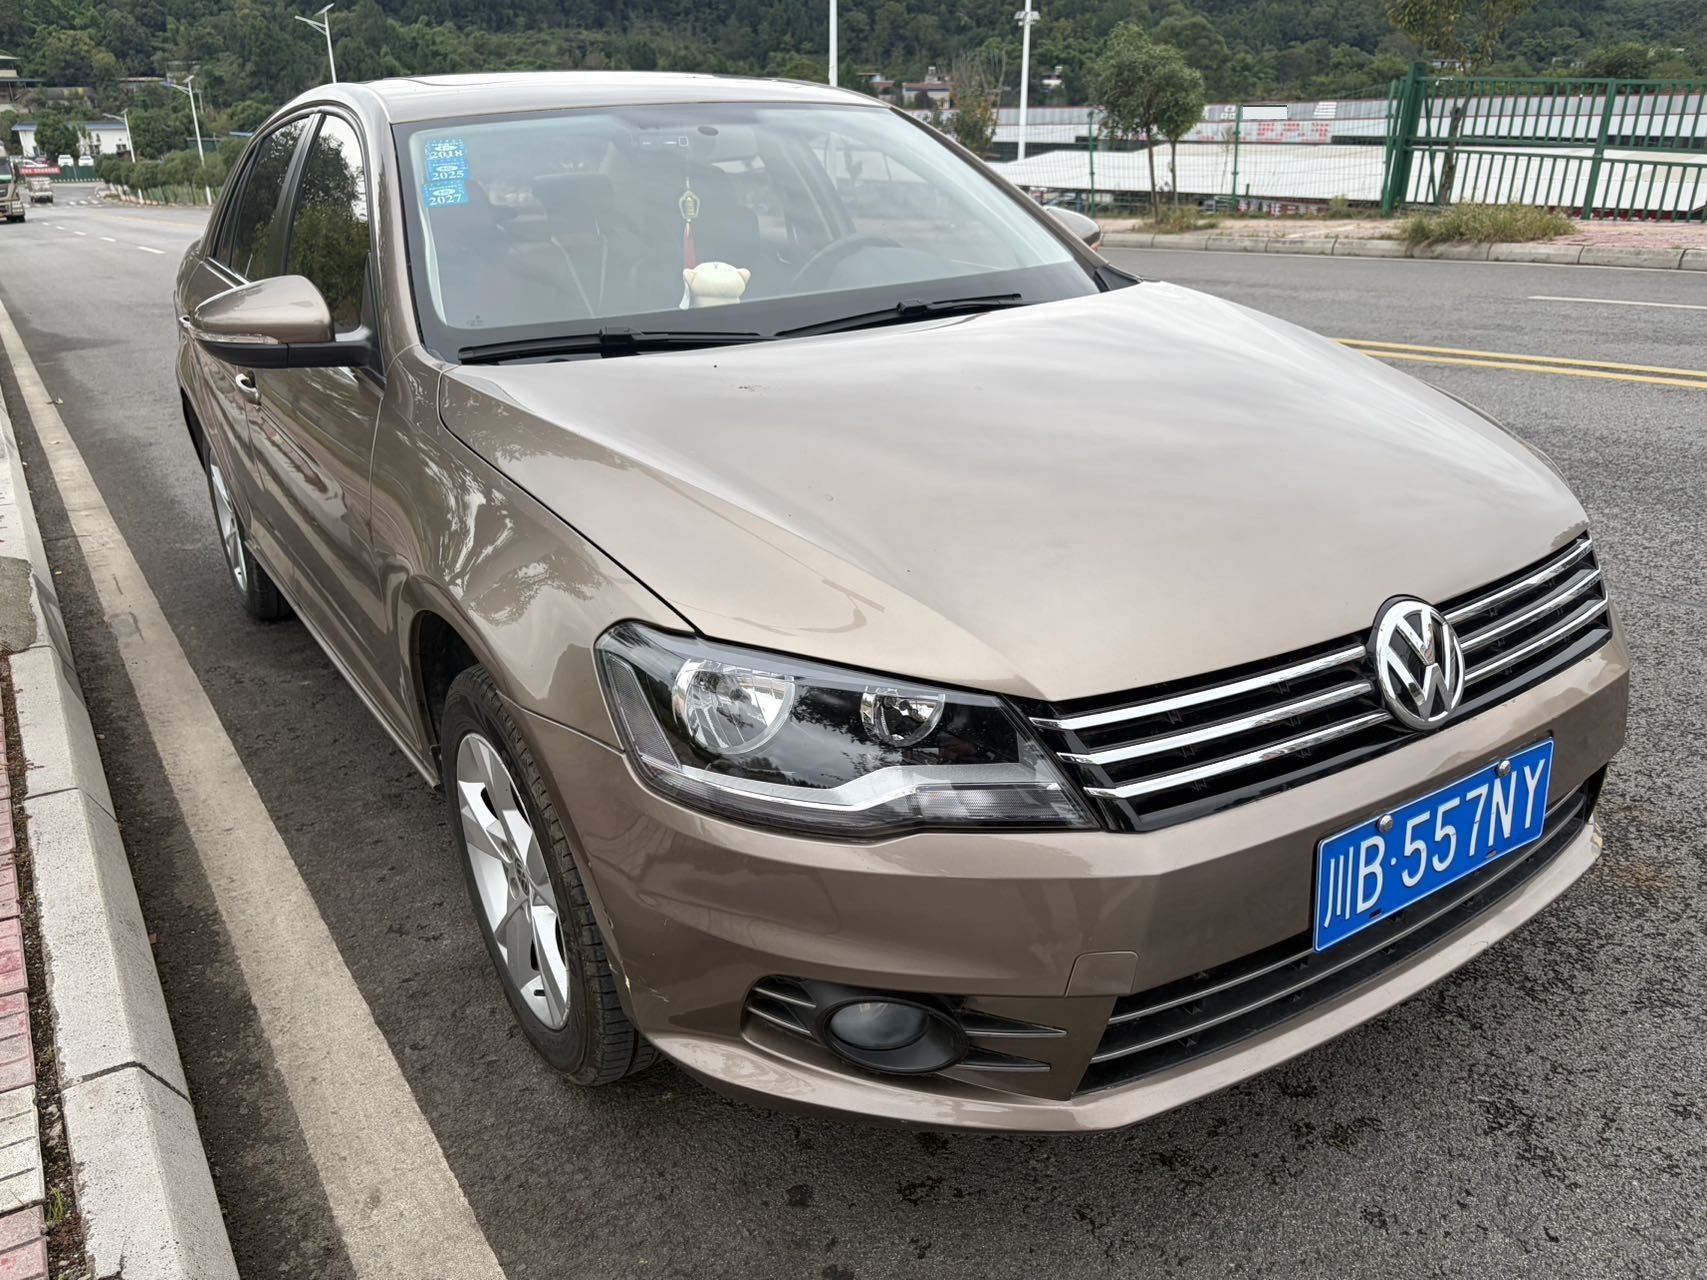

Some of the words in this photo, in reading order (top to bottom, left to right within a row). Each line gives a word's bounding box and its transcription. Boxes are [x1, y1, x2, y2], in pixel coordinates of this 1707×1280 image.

[429, 193, 462, 206] 2027
[431, 170, 464, 181] 2025
[1380, 605, 1461, 726] VW
[1324, 758, 1546, 929] 川B·557NY
